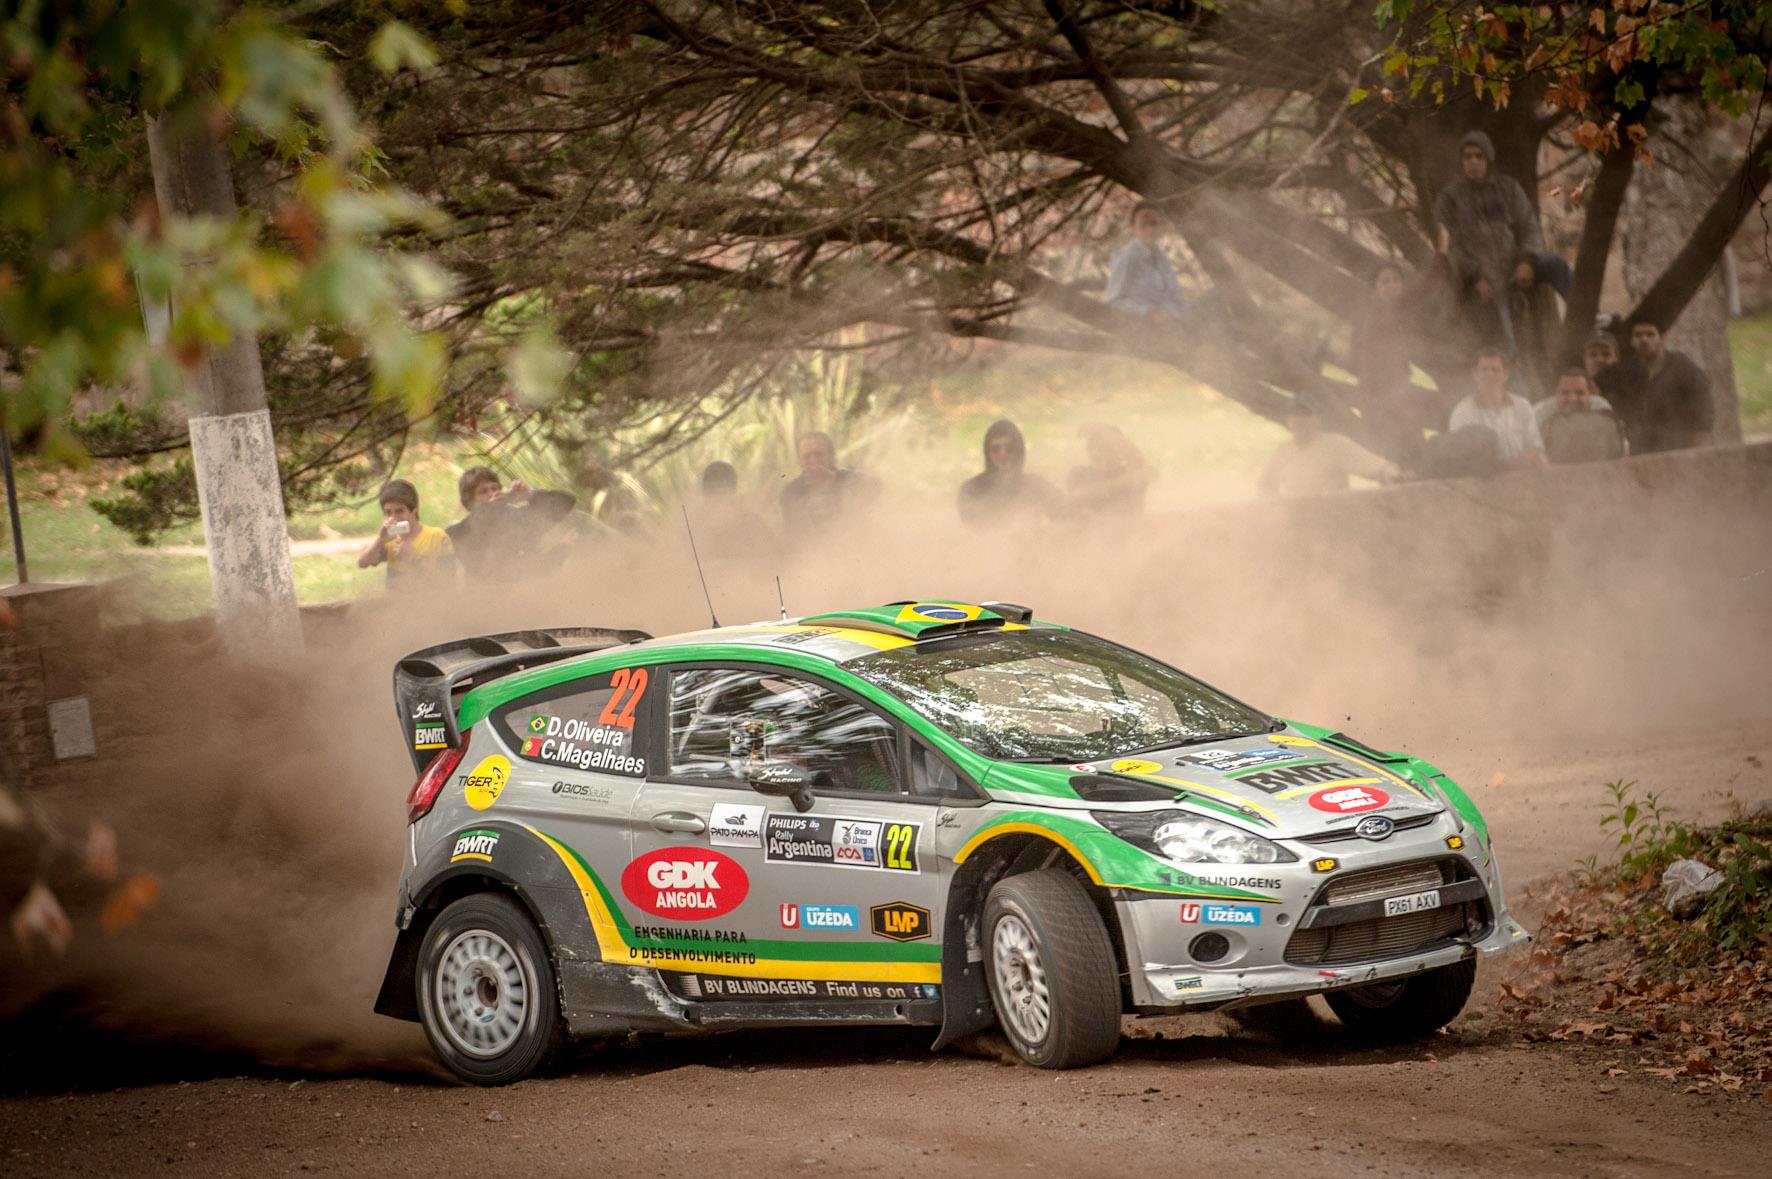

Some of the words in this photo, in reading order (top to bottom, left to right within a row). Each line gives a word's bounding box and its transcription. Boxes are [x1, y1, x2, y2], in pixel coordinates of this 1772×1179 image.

[600, 668, 648, 728] 22
[415, 727, 446, 744] BWRT
[547, 716, 624, 747] D.Oliveira
[541, 739, 645, 774] C.Magalhaes
[459, 775, 492, 787] TIGER
[1235, 762, 1364, 794] BWRT
[769, 818, 807, 830] PHILIPS
[775, 830, 794, 842] Rally
[453, 836, 498, 857] BWRT
[769, 837, 833, 859] Argentina
[886, 824, 913, 869] 22
[647, 861, 722, 889] GDK
[1177, 875, 1195, 886] BV
[1198, 876, 1282, 889] BLINDAGENS
[655, 891, 717, 908] ANGOLA
[884, 910, 919, 933] LMP
[634, 926, 709, 942] ENGENHARIA
[714, 930, 748, 944] PARA
[629, 947, 638, 959] O
[641, 947, 756, 965] DESENVOLVIMENTO
[703, 979, 723, 994] BV
[726, 979, 817, 995] BLINDAGENS
[826, 981, 859, 997] Find
[863, 986, 882, 998] us
[886, 986, 907, 998] on
